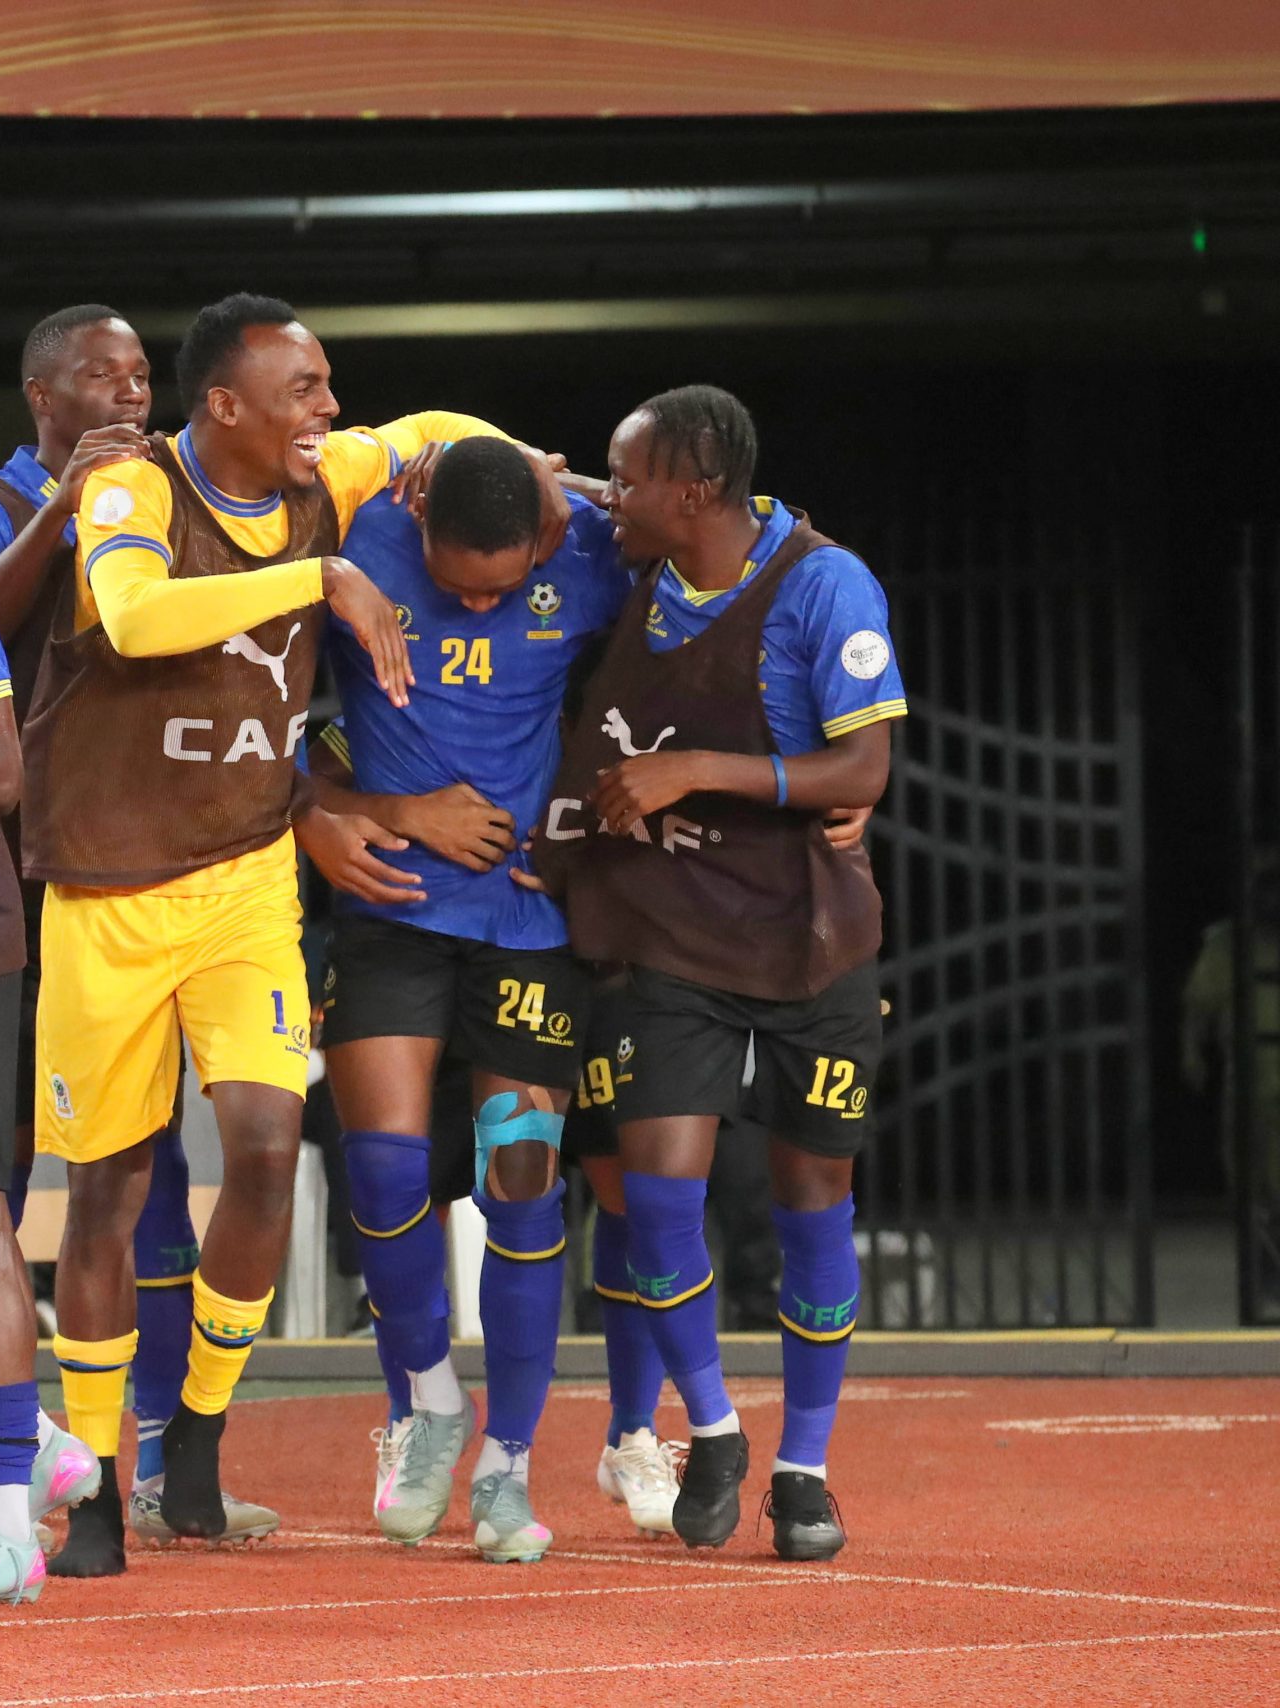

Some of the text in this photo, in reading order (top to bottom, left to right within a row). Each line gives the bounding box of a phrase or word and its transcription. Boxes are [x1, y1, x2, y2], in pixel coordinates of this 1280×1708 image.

[440, 637, 493, 685] 24
[163, 710, 309, 763] CAF
[271, 990, 288, 1035] 1
[497, 978, 546, 1031] 24
[577, 1057, 614, 1109] 19
[806, 1056, 855, 1109] 12
